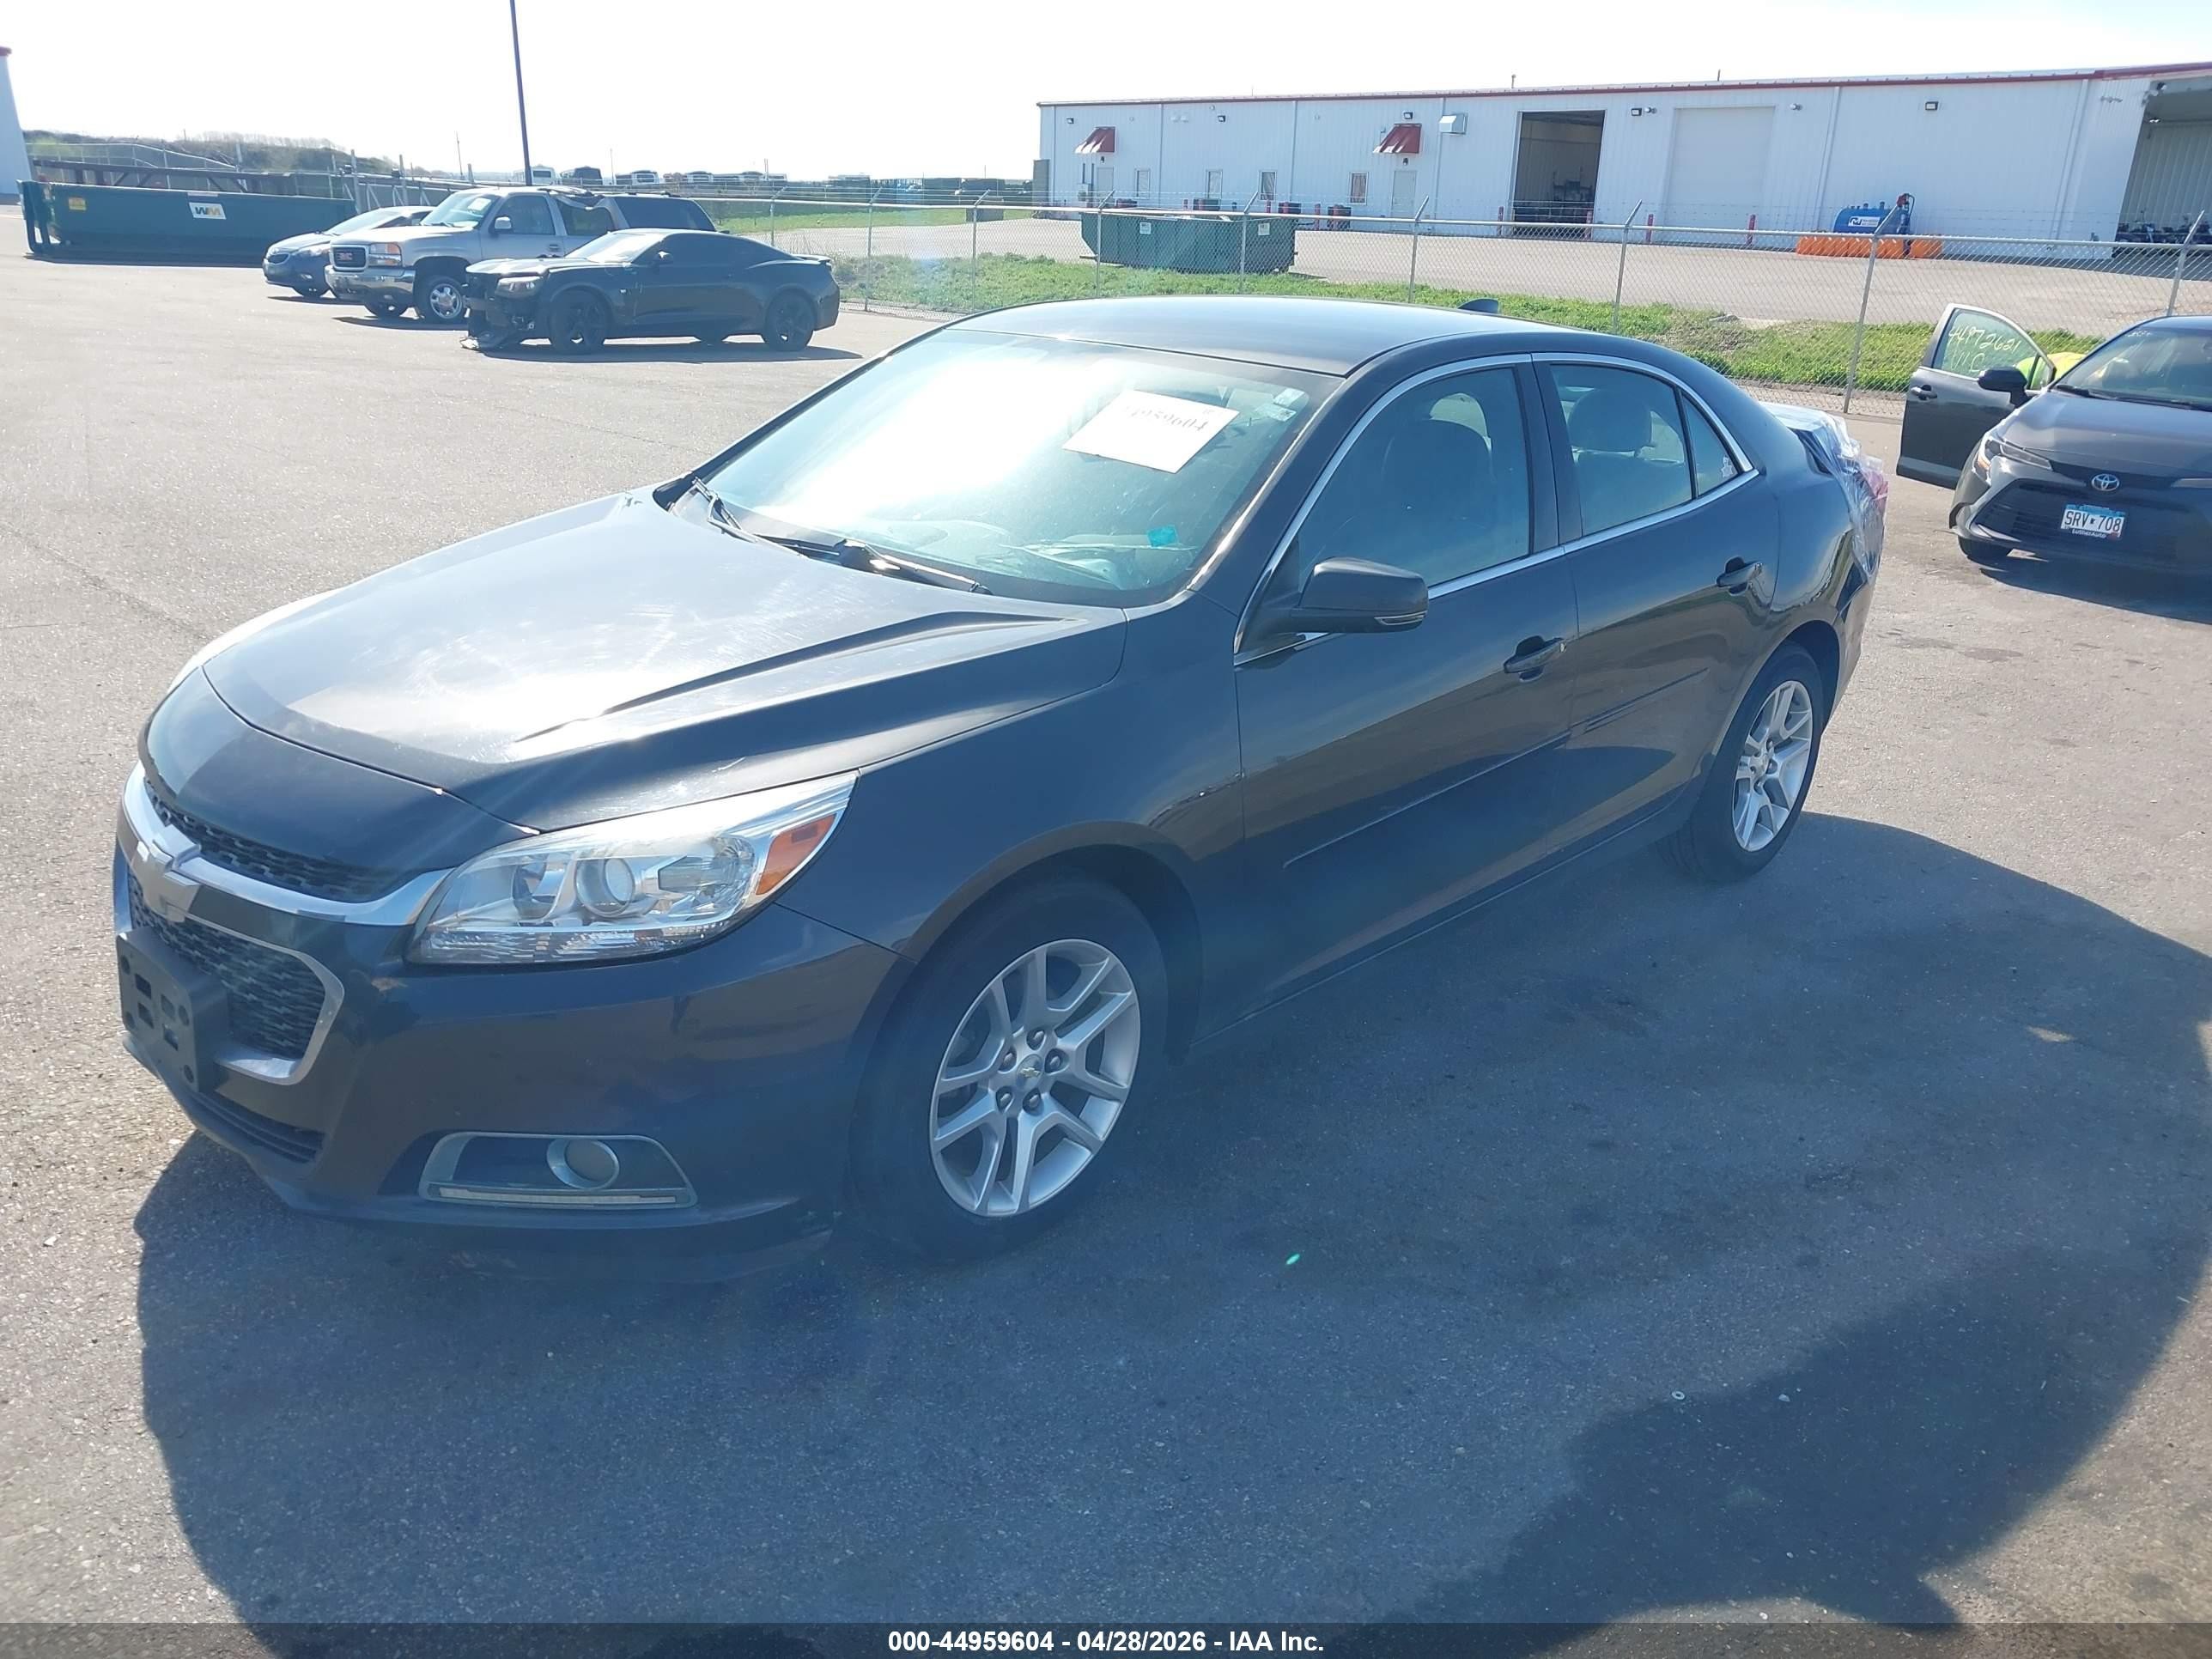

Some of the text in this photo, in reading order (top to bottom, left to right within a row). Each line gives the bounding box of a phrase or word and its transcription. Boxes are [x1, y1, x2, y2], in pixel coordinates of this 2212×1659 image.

[194, 206, 222, 216] WM
[2064, 510, 2122, 532] SRV 708
